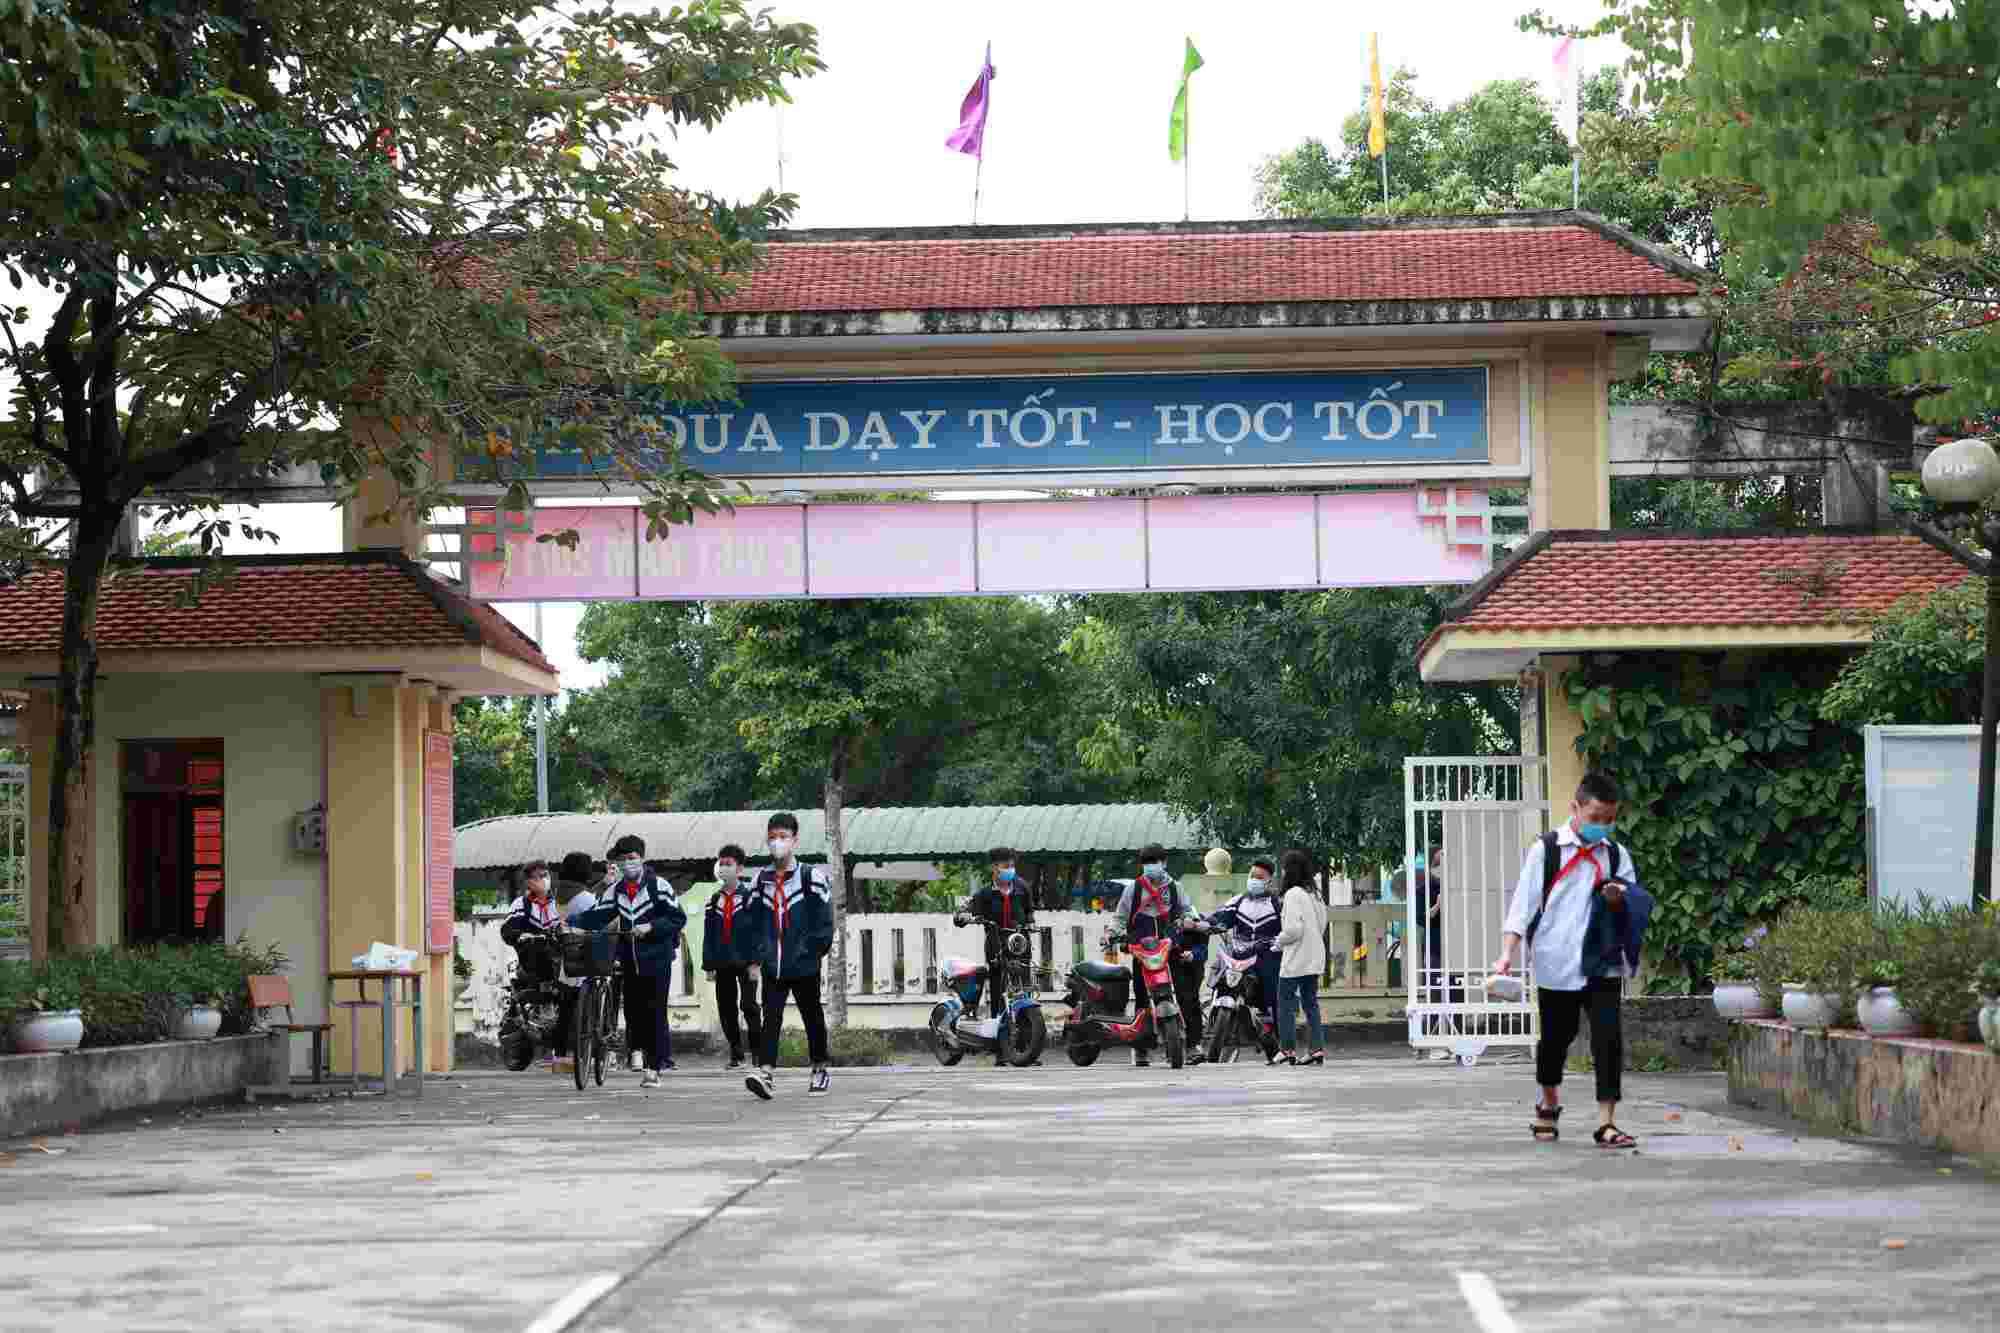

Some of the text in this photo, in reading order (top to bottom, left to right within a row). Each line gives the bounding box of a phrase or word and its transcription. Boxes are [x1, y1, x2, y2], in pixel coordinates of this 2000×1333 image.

[802, 411, 947, 461] DẠY
[968, 388, 1097, 449] TỐT
[1154, 402, 1294, 455] HỌC
[1314, 381, 1444, 441] TỐT
